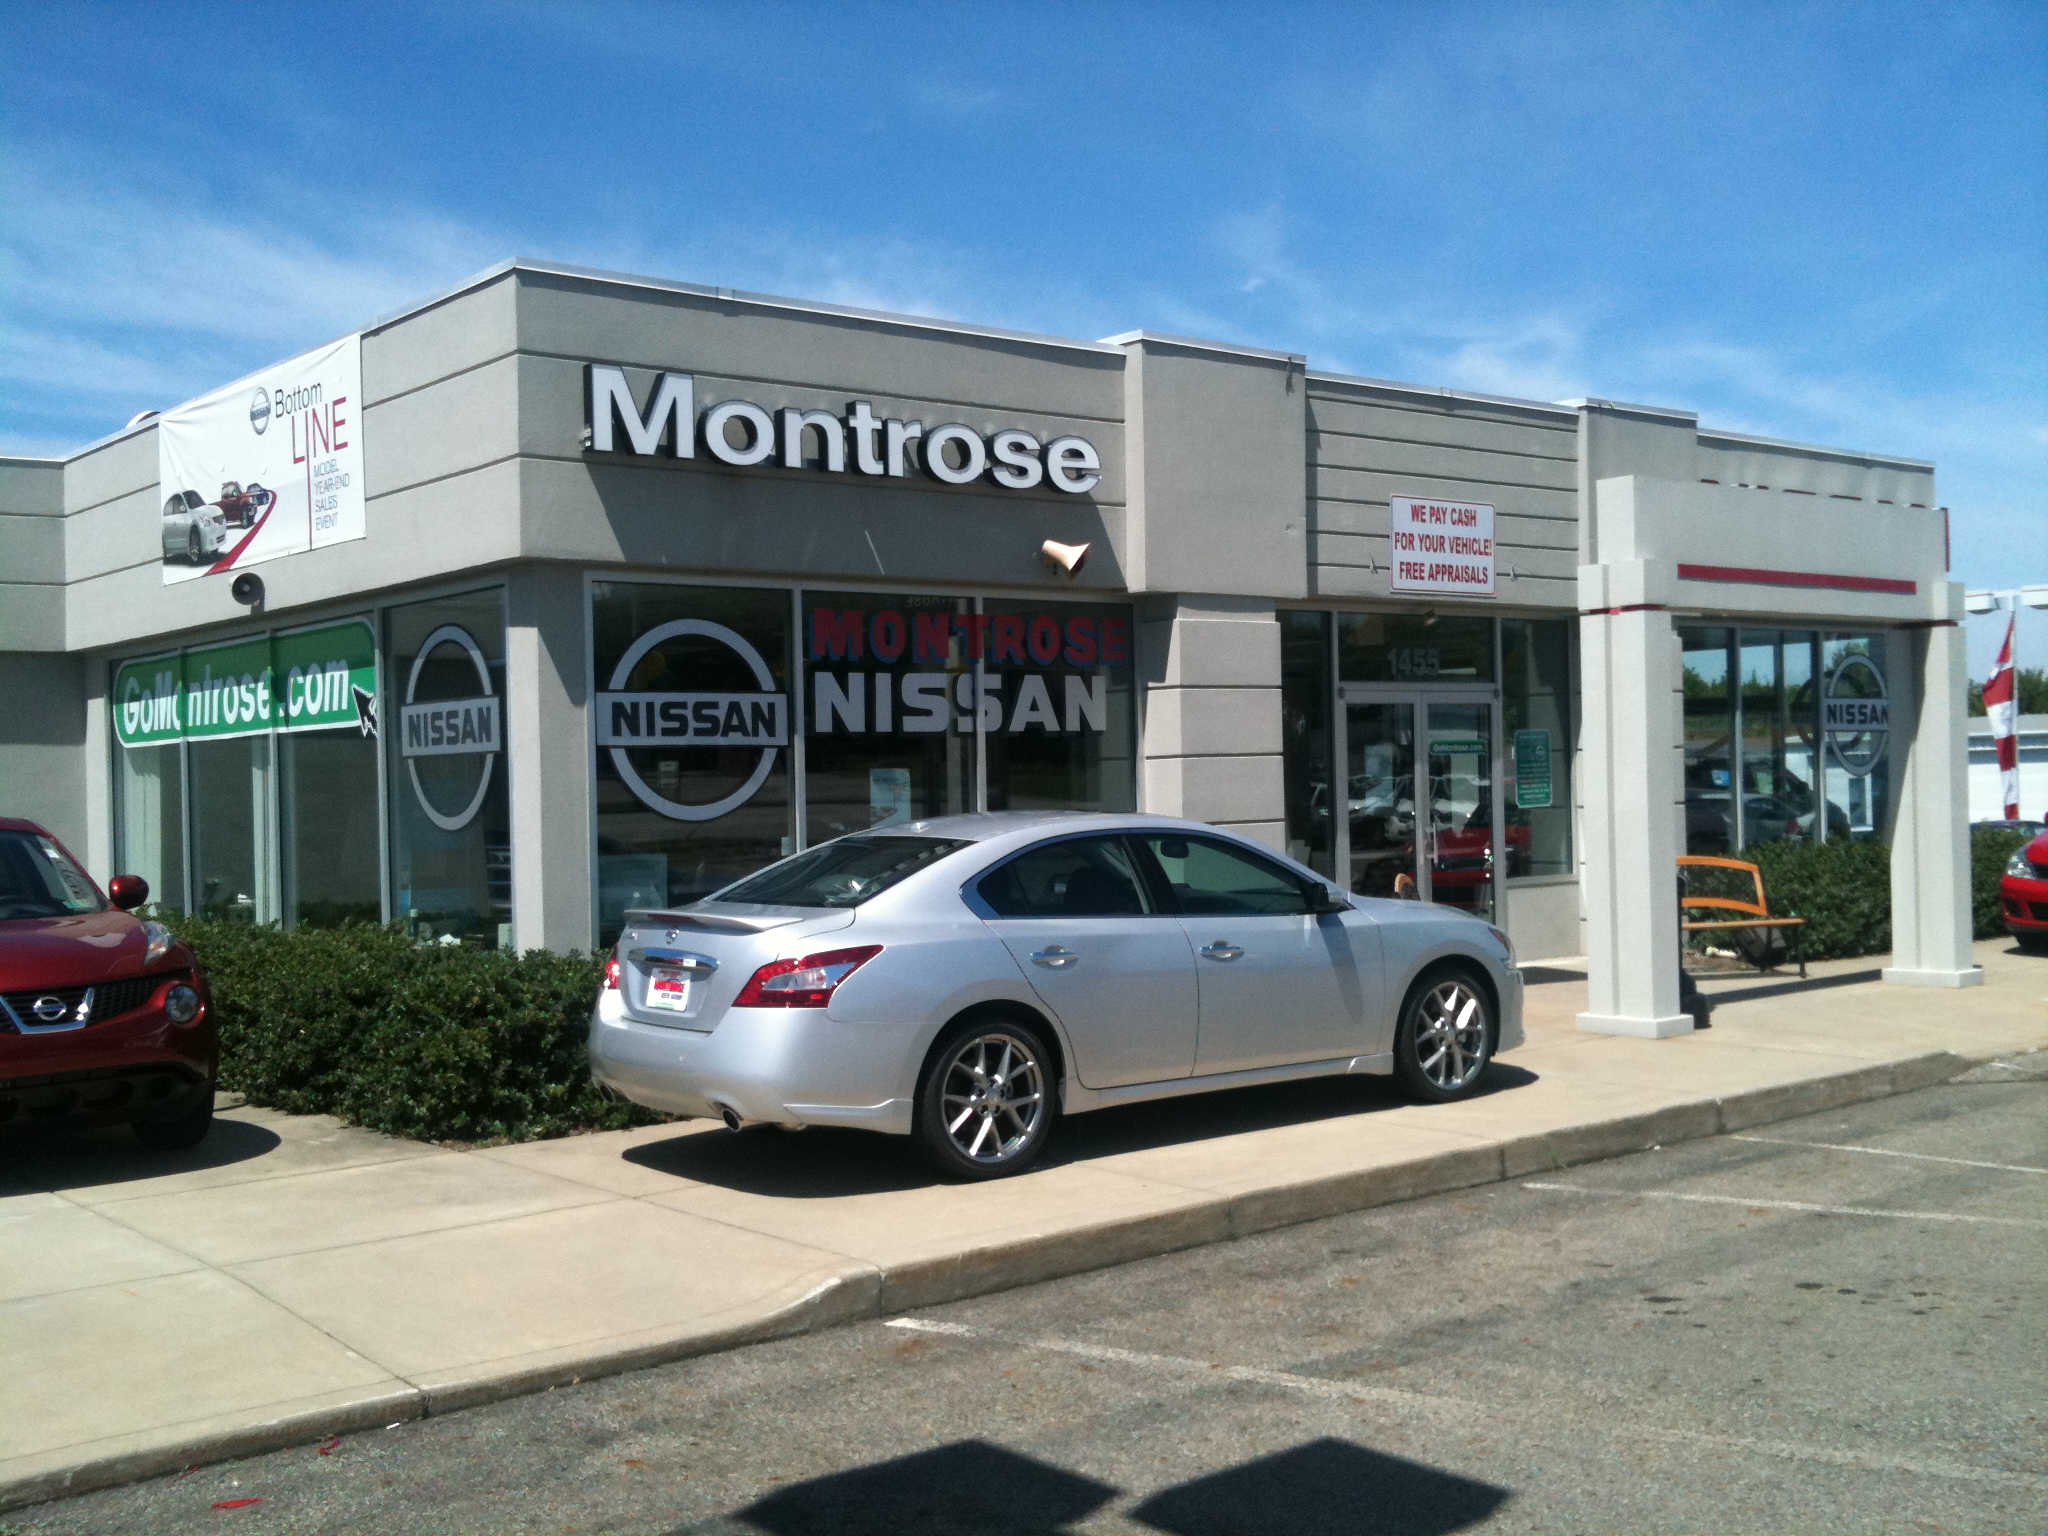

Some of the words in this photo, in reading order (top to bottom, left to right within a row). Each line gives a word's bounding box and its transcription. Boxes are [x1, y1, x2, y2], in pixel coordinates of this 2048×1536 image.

[275, 382, 322, 419] Bottom
[291, 396, 348, 465] LINE
[585, 364, 1101, 494] Montrose
[314, 459, 339, 477] MODEL
[314, 473, 350, 495] YEAR-END
[315, 495, 338, 514] SALES
[1411, 504, 1426, 523] WE
[1430, 506, 1447, 524] PAY
[1450, 507, 1477, 527] CASH
[315, 512, 338, 531] EVENT
[1395, 532, 1415, 551] FOR
[1418, 533, 1446, 553] YOUR
[1448, 536, 1492, 557] VEHICLE!
[1400, 562, 1426, 580] FREE
[1428, 563, 1488, 584] APPRAISALS
[809, 608, 1128, 667] MONTROSE
[1387, 648, 1440, 676] 1455
[814, 671, 1107, 732] NISSAN
[1826, 703, 1888, 725] NISSAN
[408, 706, 492, 748] NISSAN
[611, 701, 776, 737] NISSAN
